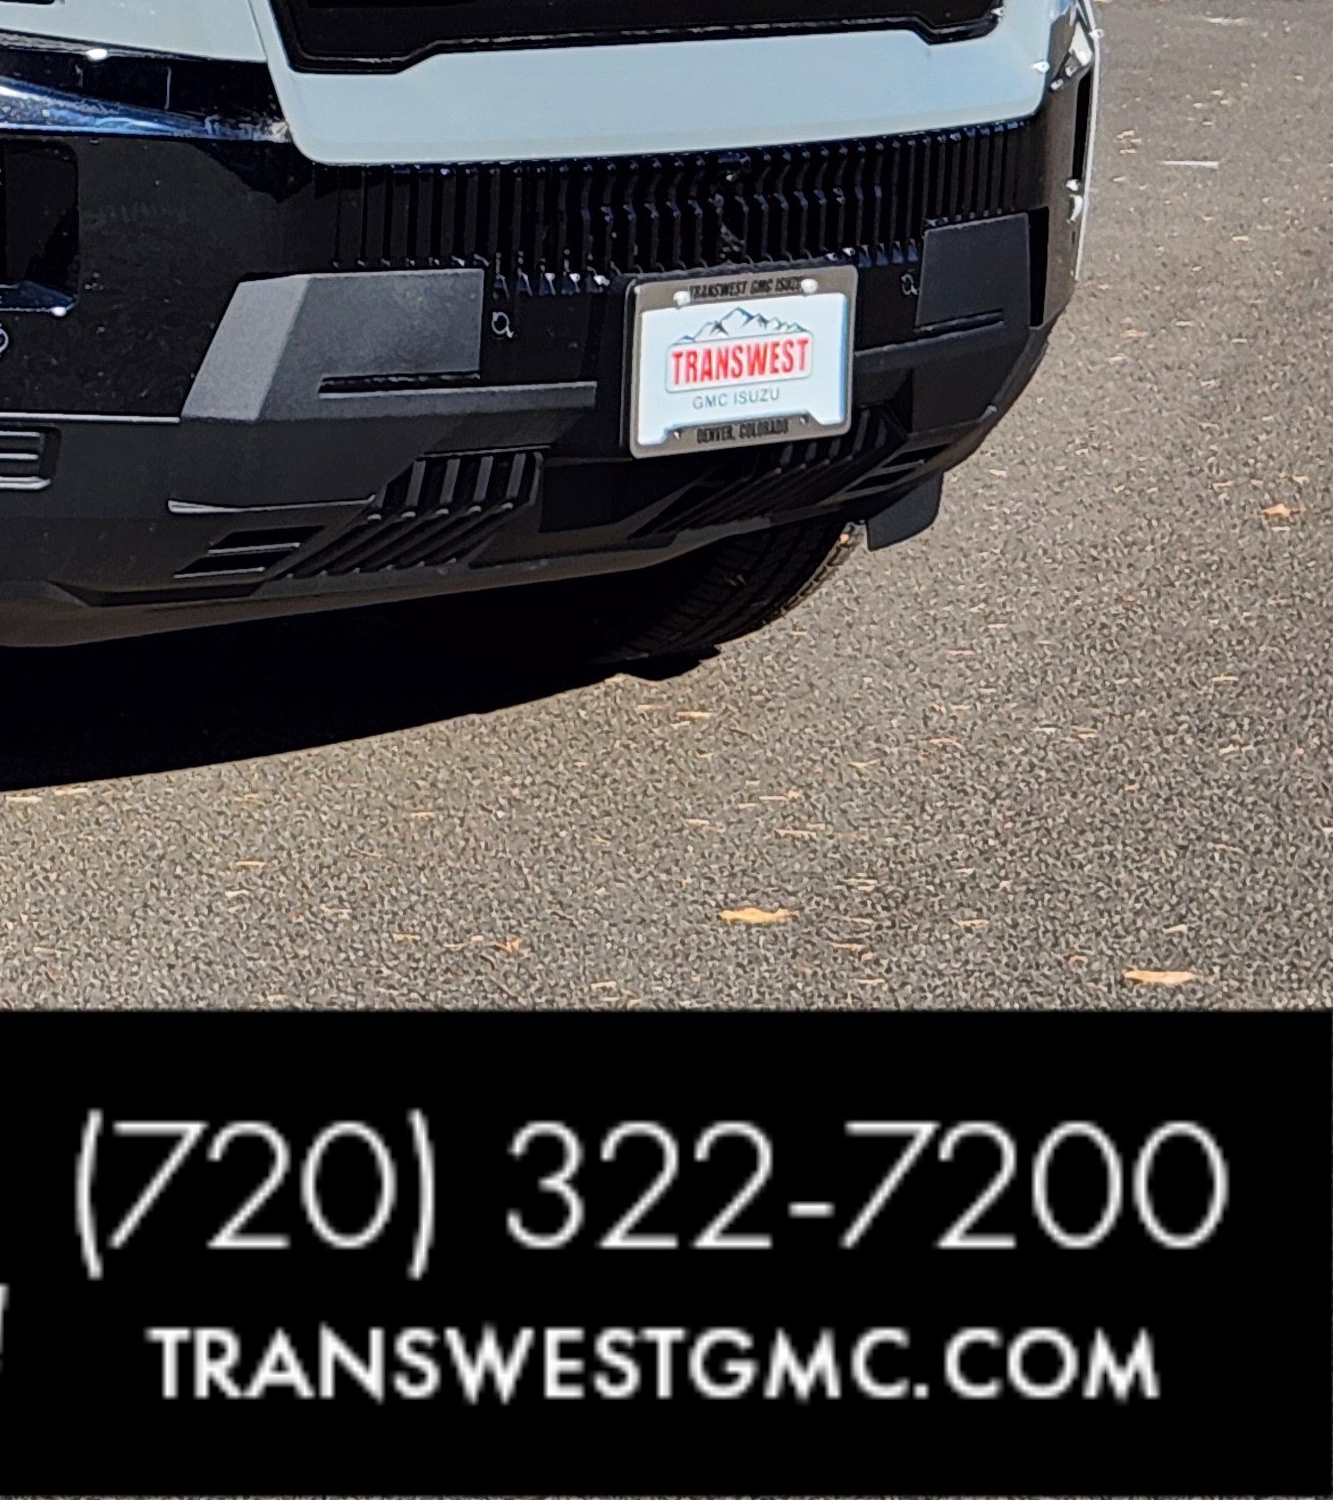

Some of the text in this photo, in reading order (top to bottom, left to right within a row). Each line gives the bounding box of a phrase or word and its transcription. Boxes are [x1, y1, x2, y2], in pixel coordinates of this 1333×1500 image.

[672, 339, 809, 384] TRANSWEST
[693, 388, 780, 409] GMC ISUZU
[739, 418, 789, 438] COLORADO
